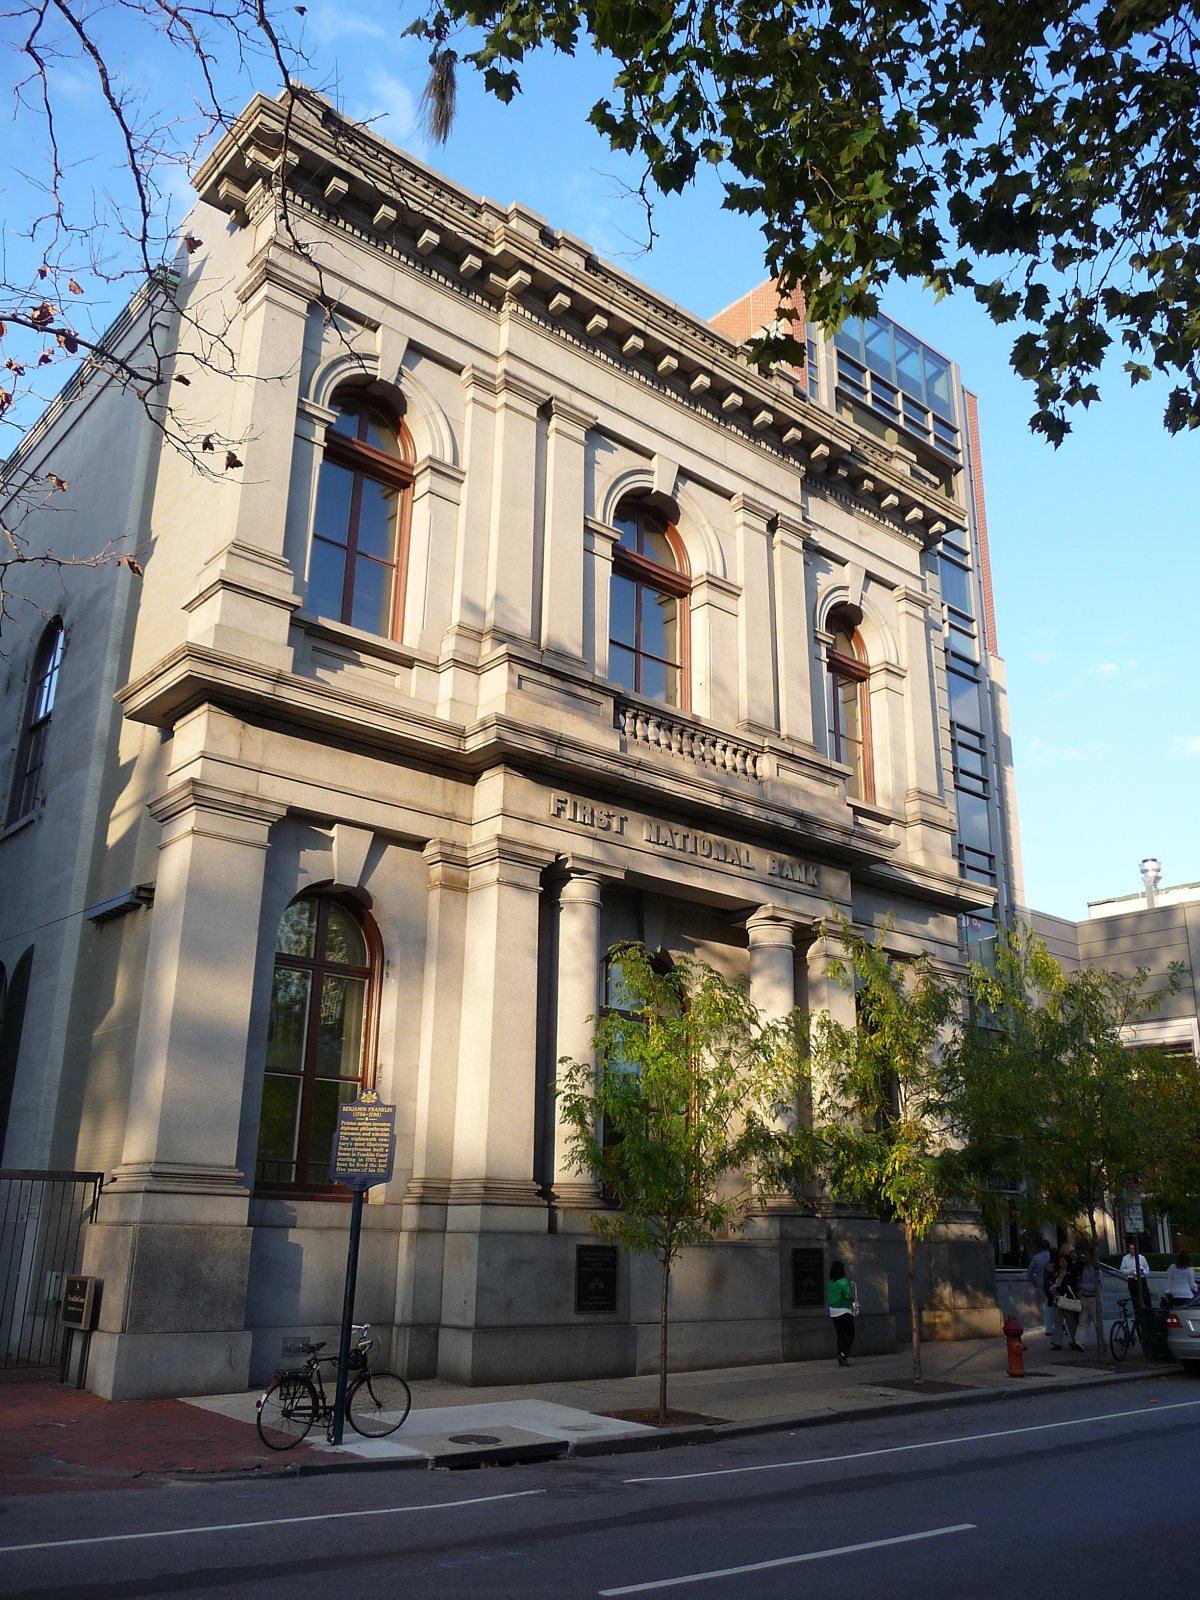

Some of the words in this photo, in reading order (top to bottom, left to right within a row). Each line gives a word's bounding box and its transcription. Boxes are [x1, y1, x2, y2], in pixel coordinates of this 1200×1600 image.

[550, 792, 628, 834] FIRST
[643, 821, 756, 872] NATIONAL
[766, 854, 820, 888] BANK
